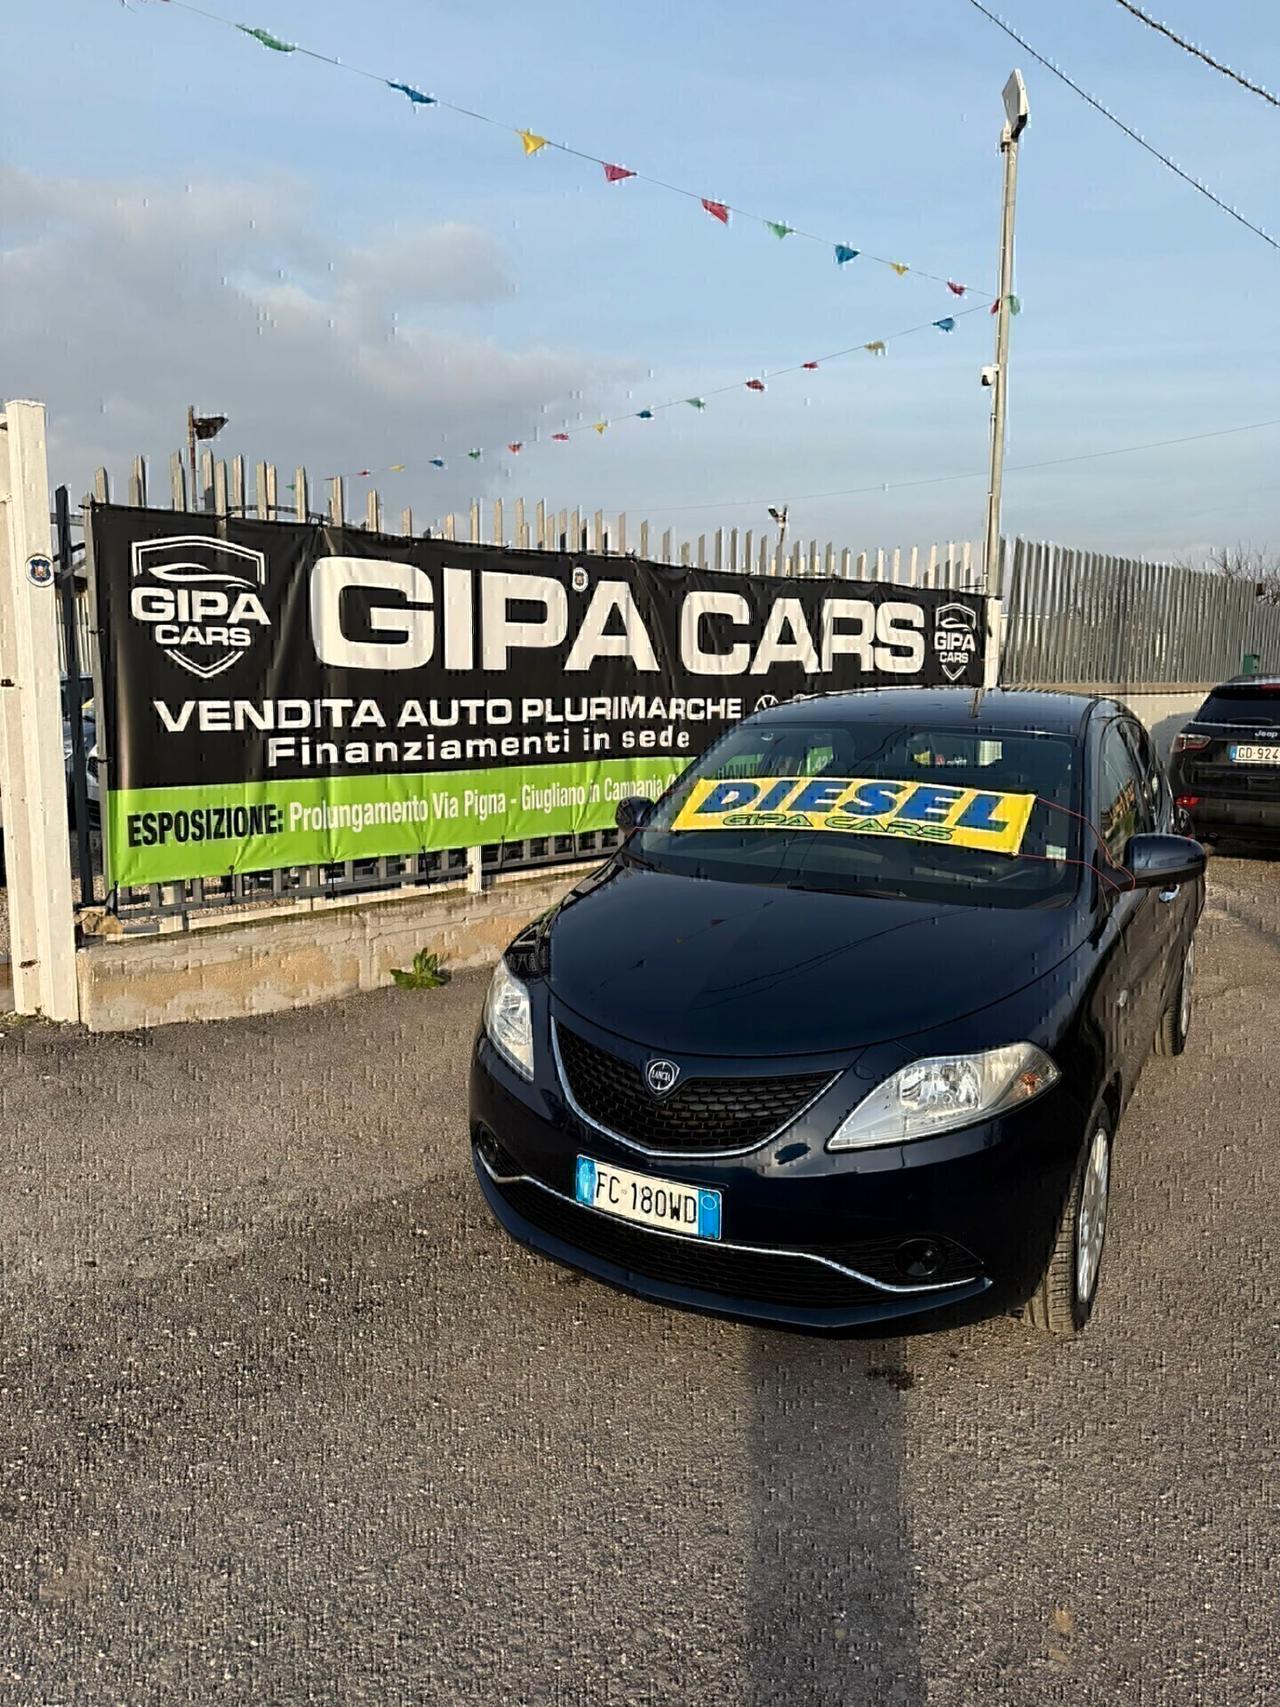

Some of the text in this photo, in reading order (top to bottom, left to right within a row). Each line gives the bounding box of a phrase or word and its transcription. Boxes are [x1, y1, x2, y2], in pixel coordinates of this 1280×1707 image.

[131, 587, 272, 625] GIPA
[310, 556, 925, 675] GIPA CARS
[155, 624, 251, 646] CARS
[934, 631, 976, 652] GIPA
[939, 651, 969, 664] CARS
[153, 695, 741, 732] VENDITA AUTO PLURIMARCHE
[268, 725, 690, 767] Finanziamenti in sede
[1254, 730, 1279, 738] Jeep
[1238, 747, 1253, 759] GD
[127, 804, 284, 848] ESPOSIZIONE:
[289, 792, 428, 833] Prolungamento
[432, 790, 459, 820] Via
[464, 789, 506, 821] Pigna
[521, 782, 585, 814] Giugliano
[589, 780, 601, 803] in
[693, 780, 1010, 833] DIESEL
[723, 813, 956, 841] GIPA CARS
[596, 1171, 620, 1203] FC
[631, 1182, 698, 1224] 180WD
